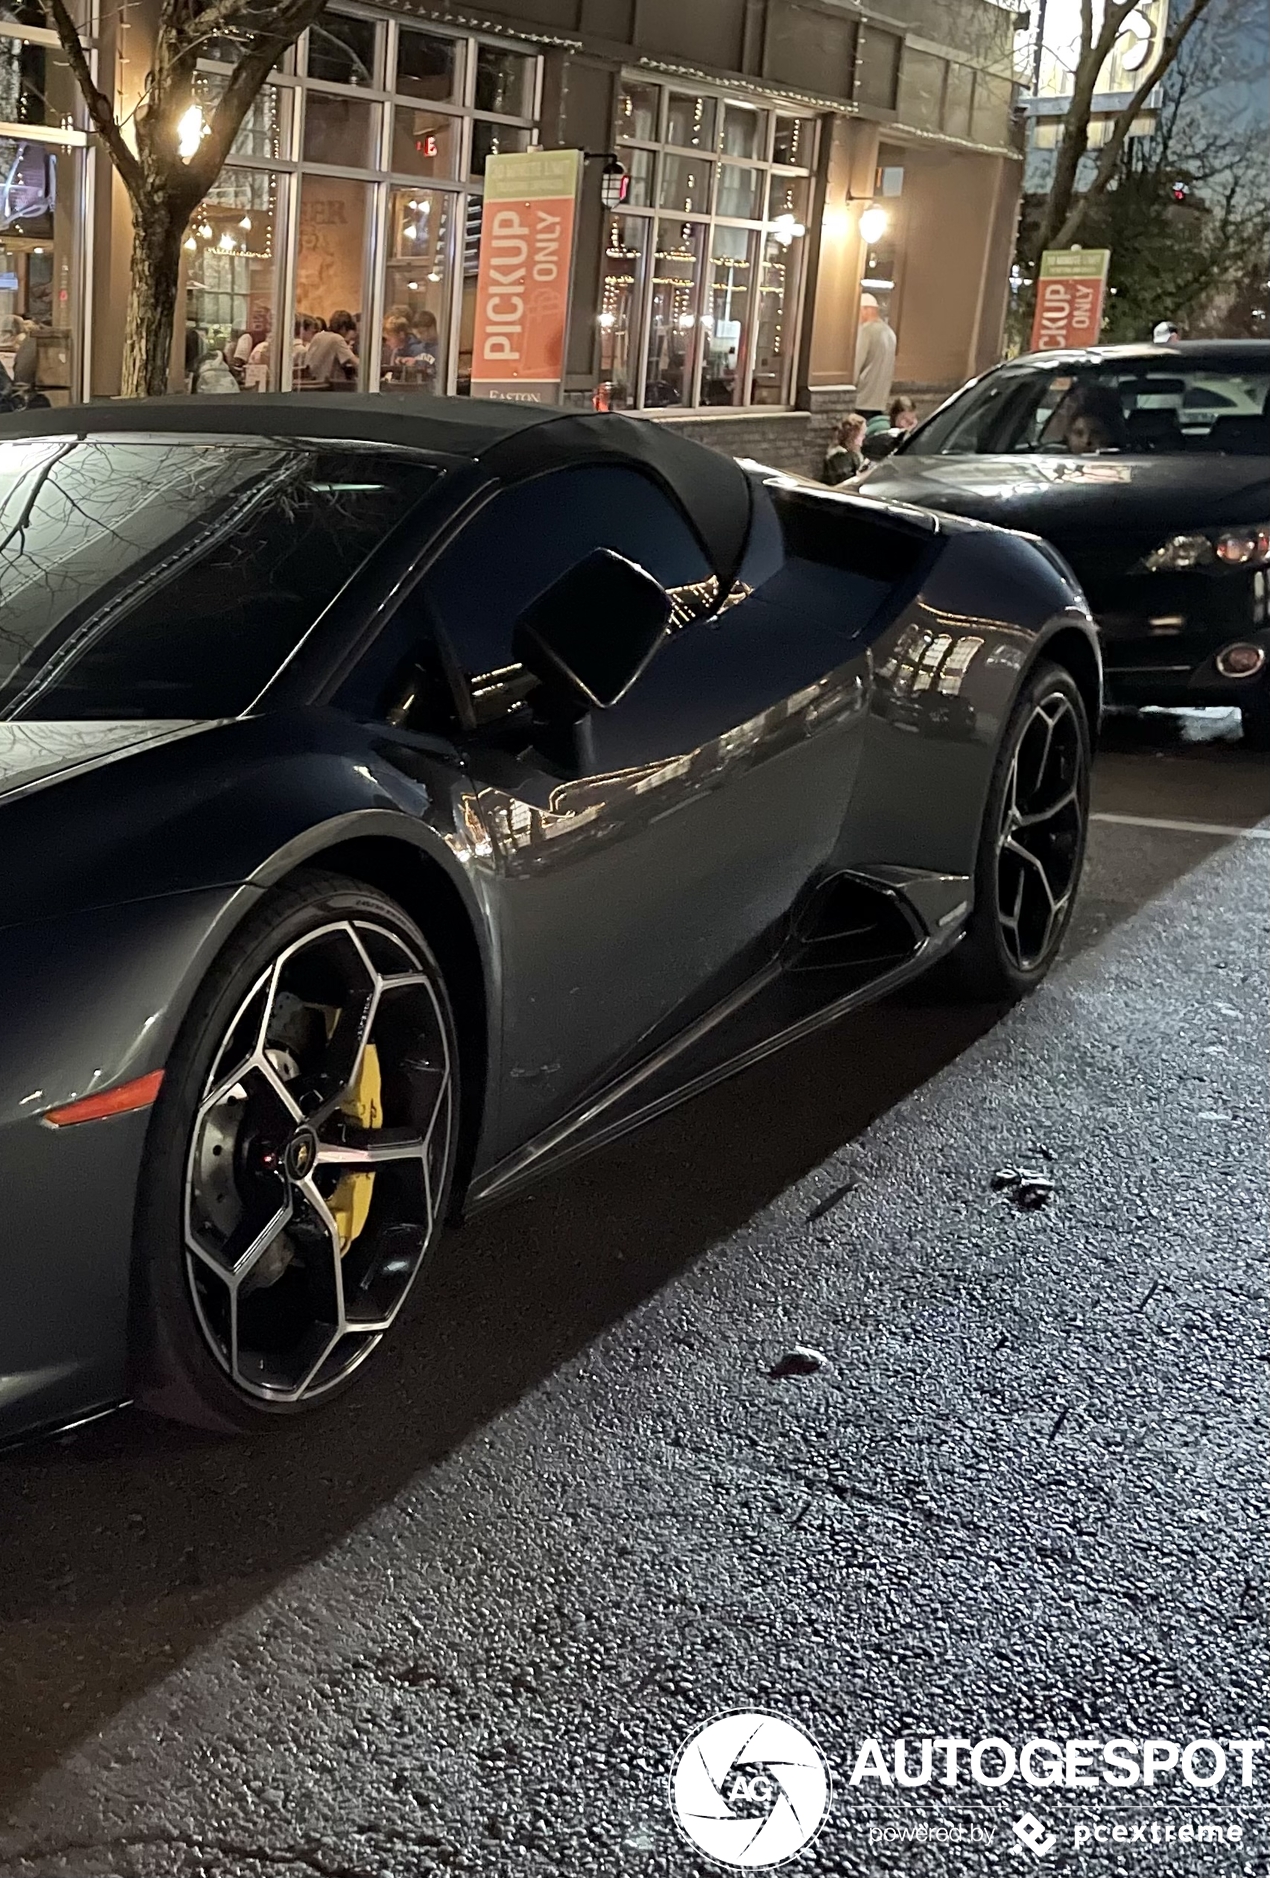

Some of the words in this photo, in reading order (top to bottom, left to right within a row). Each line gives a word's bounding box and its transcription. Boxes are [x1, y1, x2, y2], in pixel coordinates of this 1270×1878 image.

[533, 211, 562, 282] ONLY
[483, 210, 530, 360] PICKUP
[1038, 284, 1071, 350] CKUP
[1072, 284, 1094, 329] ONLY
